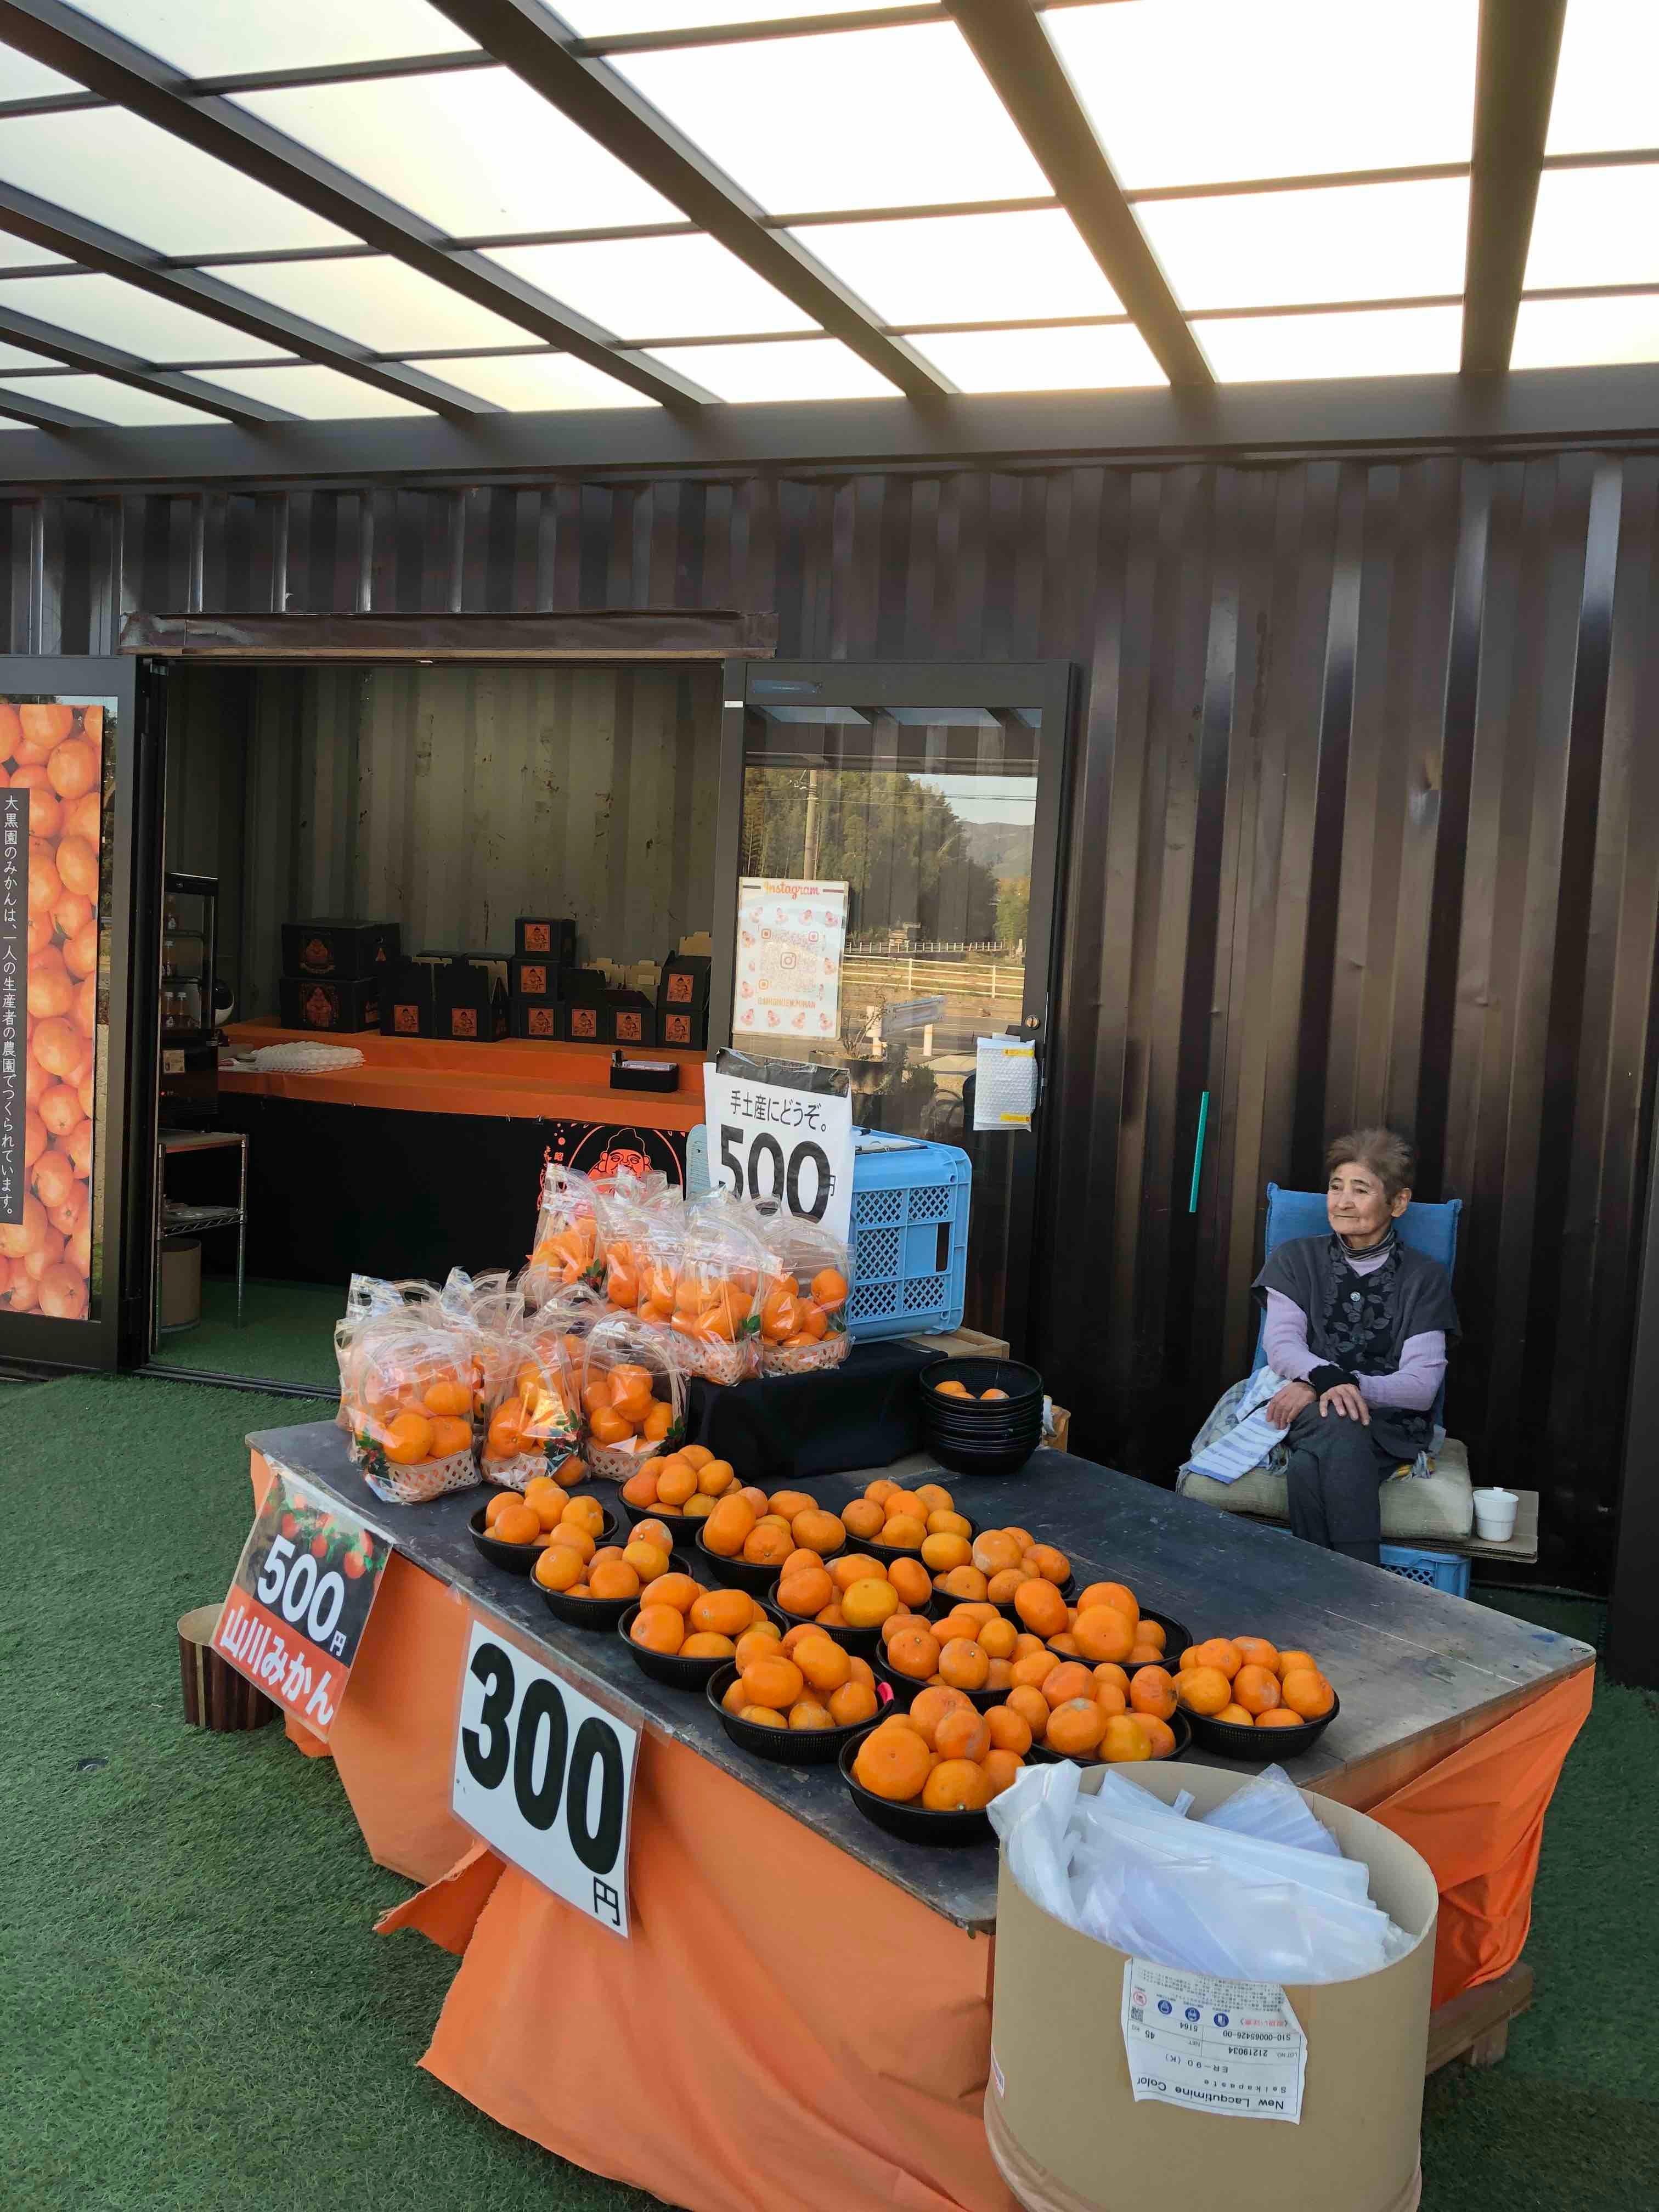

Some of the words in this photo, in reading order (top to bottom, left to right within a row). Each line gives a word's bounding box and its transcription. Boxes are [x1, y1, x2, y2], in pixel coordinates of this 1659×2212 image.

[763, 881, 820, 900] Instagram
[0, 795, 19, 1214] 大黒園のみかんは、一人の生産者の農園でつくられています。
[730, 1090, 826, 1132] 手土産にどうぞ。
[220, 1606, 334, 1725] 山川みかん
[1137, 2076, 1166, 2091] Color
[1175, 2086, 1250, 2107] Lacqutimine
[1258, 2098, 1284, 2110] New
